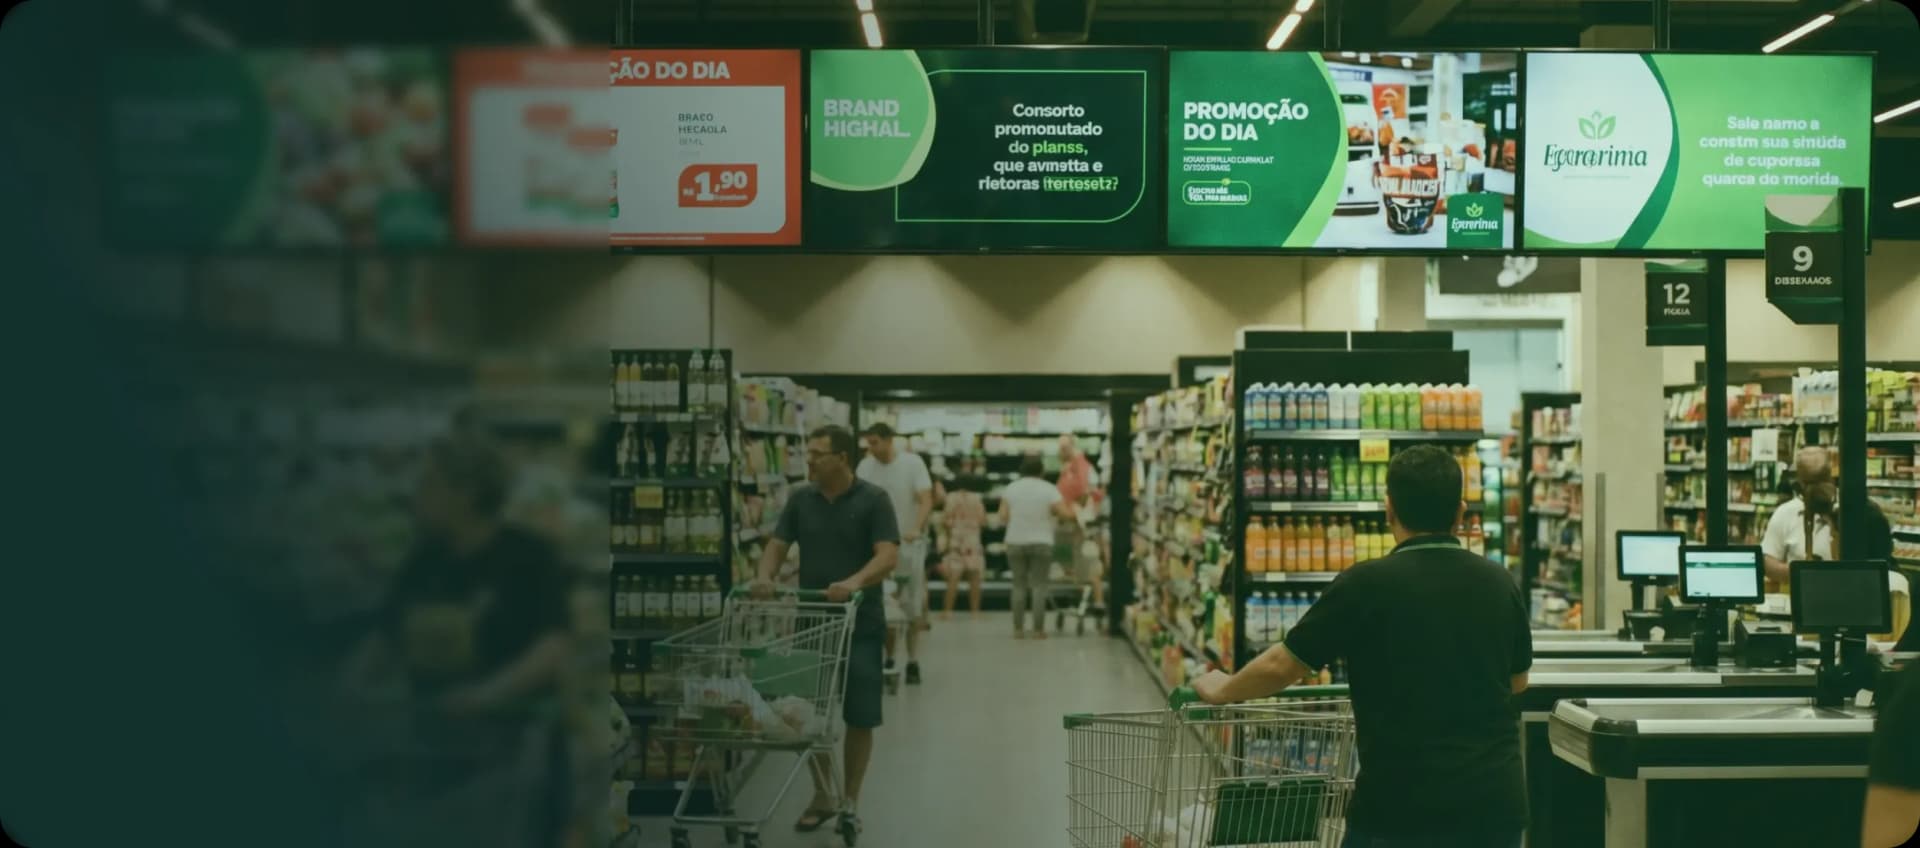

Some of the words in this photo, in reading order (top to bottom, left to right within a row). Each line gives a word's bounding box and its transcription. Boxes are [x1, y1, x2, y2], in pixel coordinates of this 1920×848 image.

[655, 61, 688, 79] DO
[692, 61, 731, 79] DIA
[823, 99, 900, 117] BRAND
[1012, 103, 1085, 117] Consorto
[1184, 98, 1309, 125] PROMOÇÃO
[1184, 123, 1216, 140] DO
[1221, 123, 1258, 140] DIA
[1810, 119, 1820, 130] a
[1008, 140, 1029, 153] do
[1762, 137, 1789, 148] sua
[993, 160, 1024, 174] que
[1092, 161, 1103, 172] e
[1723, 153, 1743, 167] de
[1758, 172, 1780, 185] do
[1792, 245, 1813, 272] 9
[1663, 283, 1690, 304] 12
